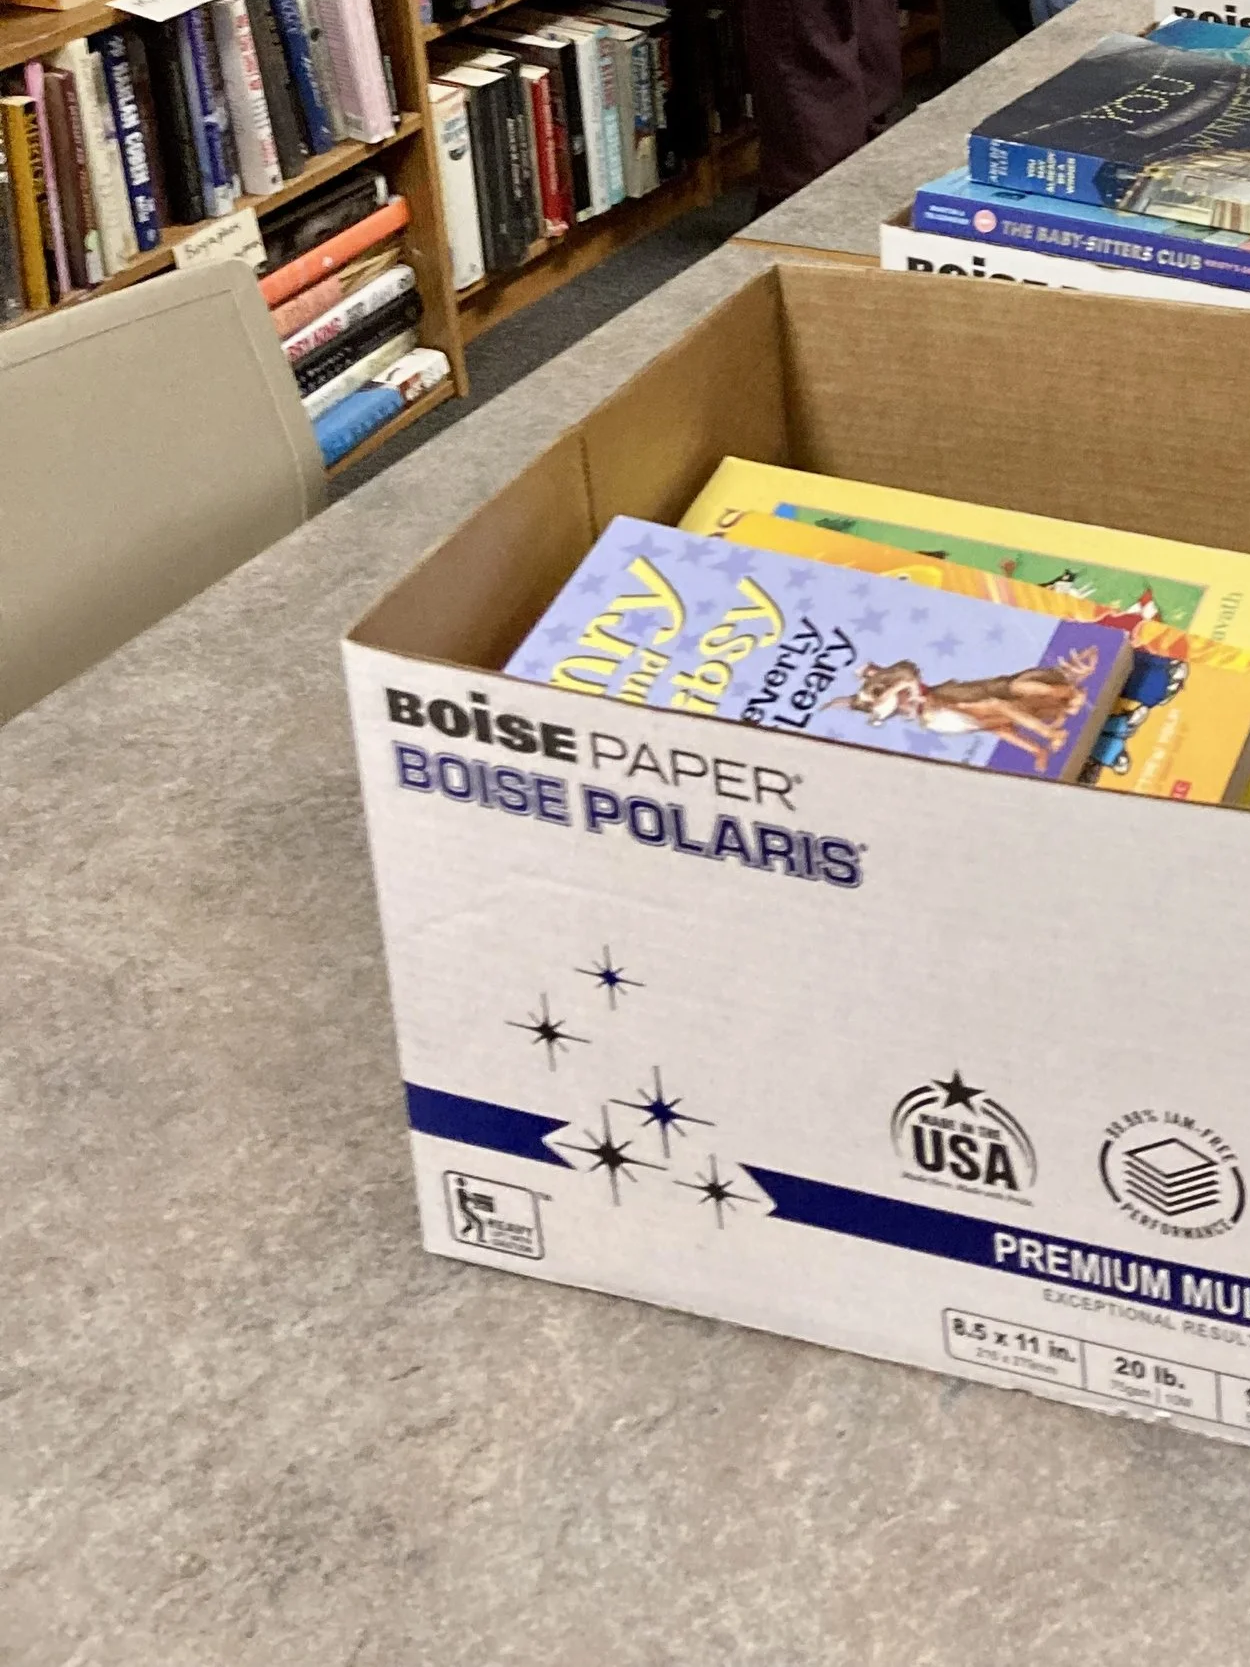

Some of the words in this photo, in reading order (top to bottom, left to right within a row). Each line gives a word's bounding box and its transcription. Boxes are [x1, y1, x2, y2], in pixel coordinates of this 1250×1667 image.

[114, 62, 141, 129] HARLAN
[1081, 74, 1195, 123] YOU
[124, 132, 151, 186] COBEN
[1003, 220, 1033, 240] THE
[1036, 227, 1154, 262] BABY-SITTERS
[1156, 248, 1203, 271] CLUB
[550, 556, 685, 694] nry
[669, 577, 785, 714] ibsy
[619, 650, 671, 706] nd
[391, 740, 573, 826] BOISE
[581, 782, 866, 890] POLARIS
[911, 1124, 1021, 1191] USA
[1164, 1111, 1239, 1163] JAM-FREE
[1120, 1201, 1236, 1240] PERFORMANCE
[993, 1230, 1173, 1302] PREMIUM
[1041, 1286, 1178, 1332] EXCEPTIONAL
[951, 1315, 989, 1345] 8.5
[993, 1328, 1008, 1347] x
[1013, 1333, 1041, 1355] 11
[1045, 1340, 1078, 1364] in.
[1114, 1355, 1146, 1380] 20
[1153, 1362, 1187, 1391] lb.
